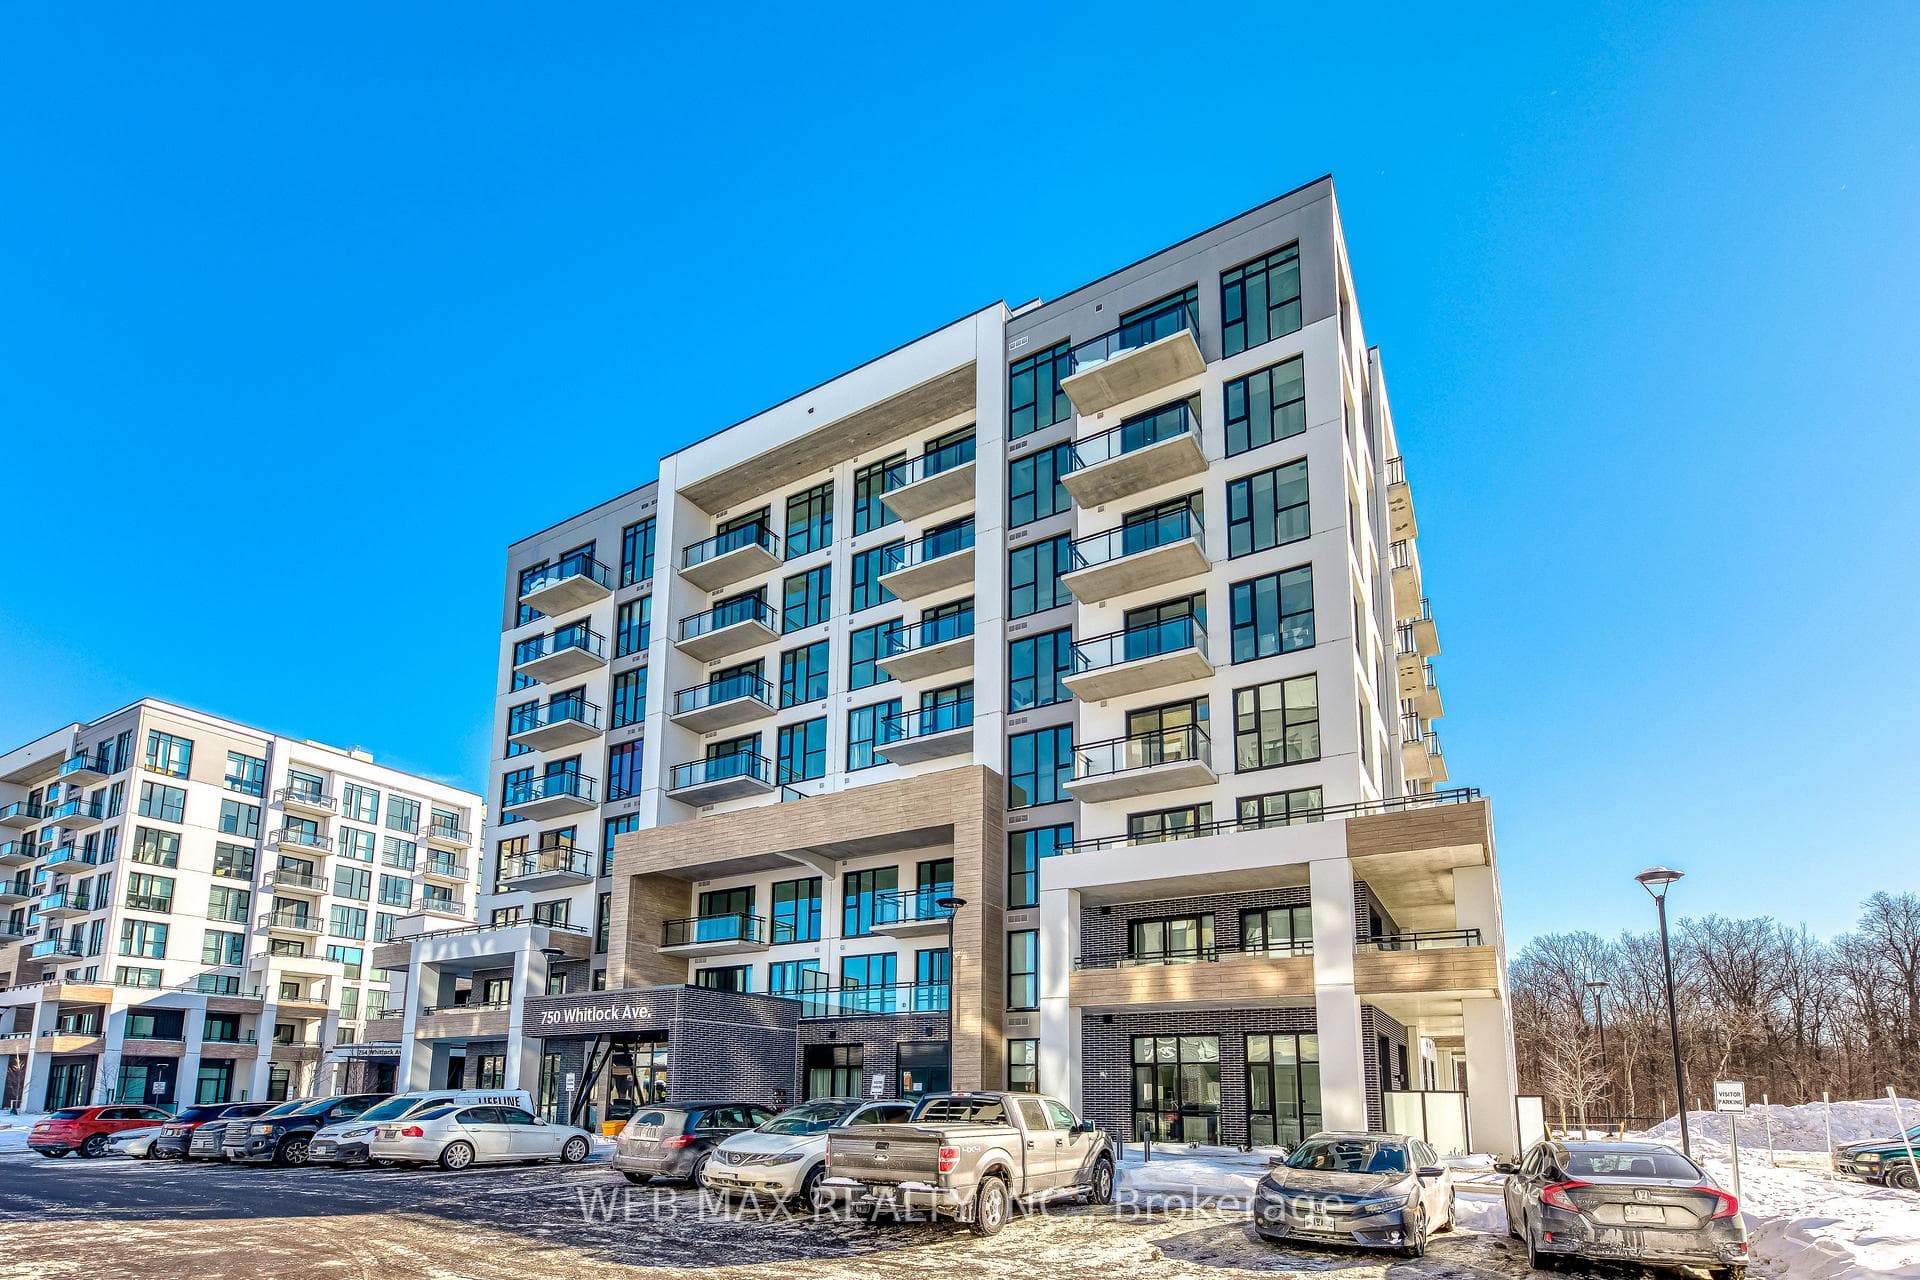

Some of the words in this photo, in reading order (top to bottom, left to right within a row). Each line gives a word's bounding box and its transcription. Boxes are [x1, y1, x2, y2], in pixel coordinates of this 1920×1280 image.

[541, 1010, 561, 1025] 750
[564, 1004, 619, 1022] Whitlock
[622, 1004, 652, 1020] Ave.
